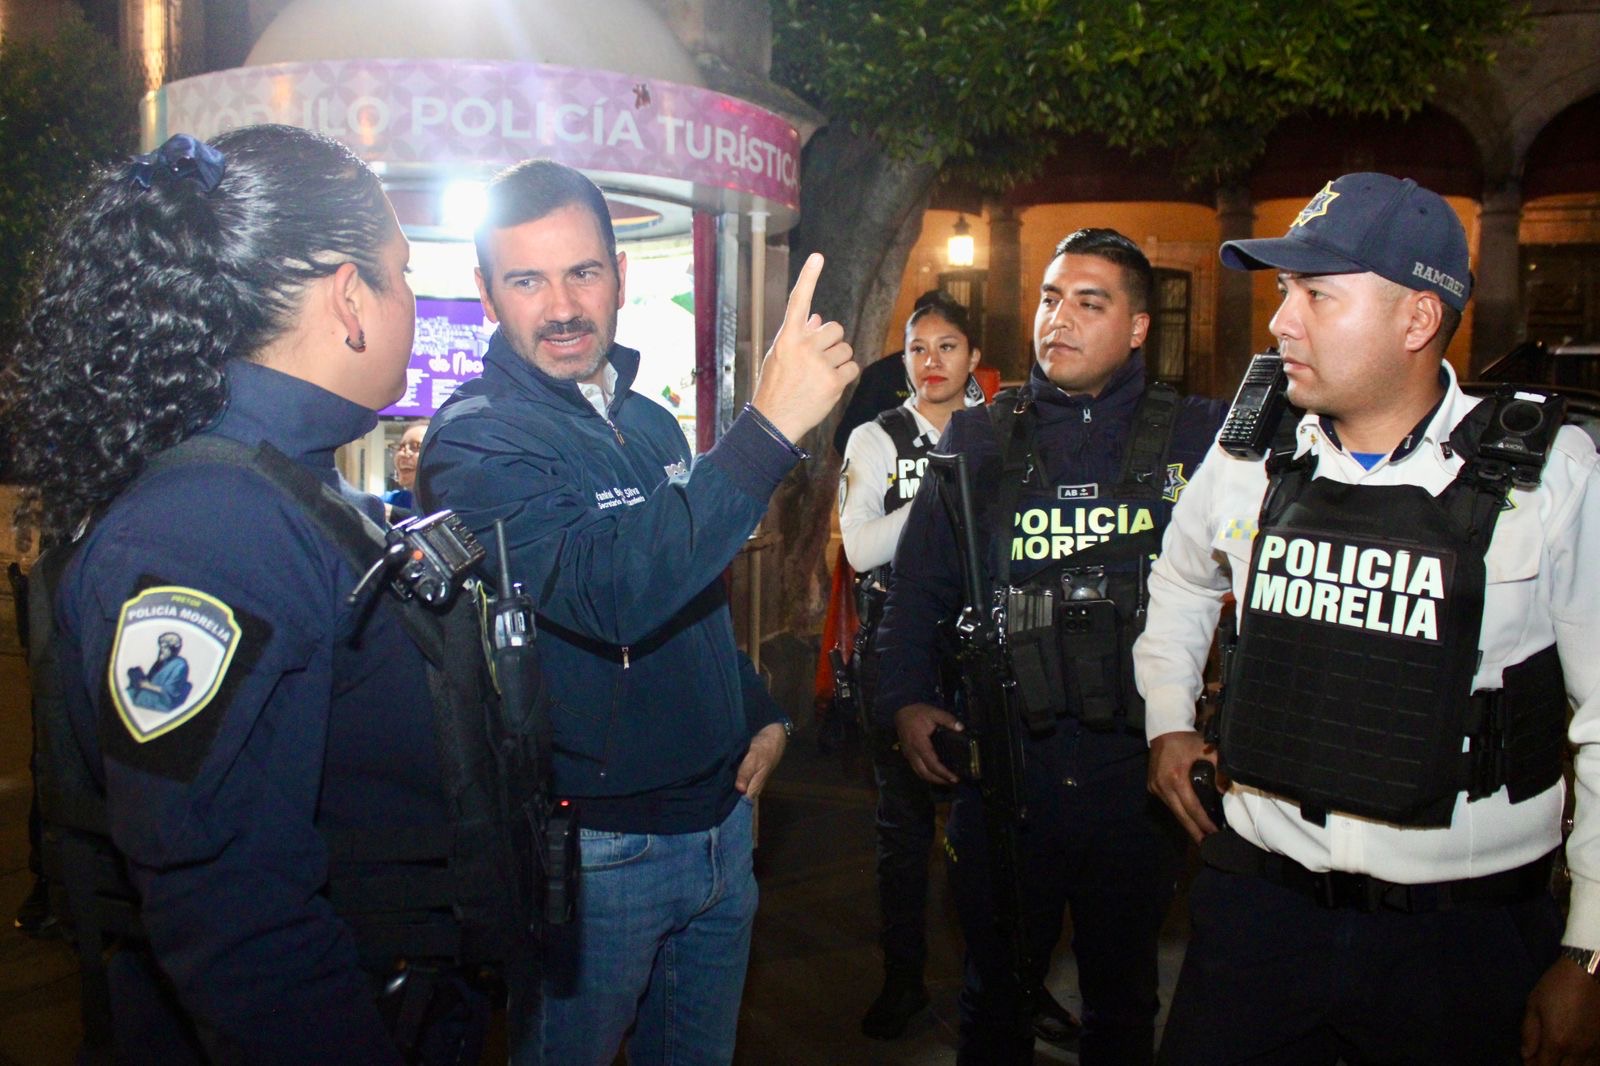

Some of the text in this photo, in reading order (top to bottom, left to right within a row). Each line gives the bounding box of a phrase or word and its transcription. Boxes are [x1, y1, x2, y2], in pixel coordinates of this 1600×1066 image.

[410, 96, 640, 149] POLICÍA
[1412, 261, 1465, 298] RAMIREZ
[1257, 535, 1444, 599] POLICÍA
[128, 605, 231, 642] POLICÍA MORELIA
[1250, 572, 1438, 640] MORELIA
